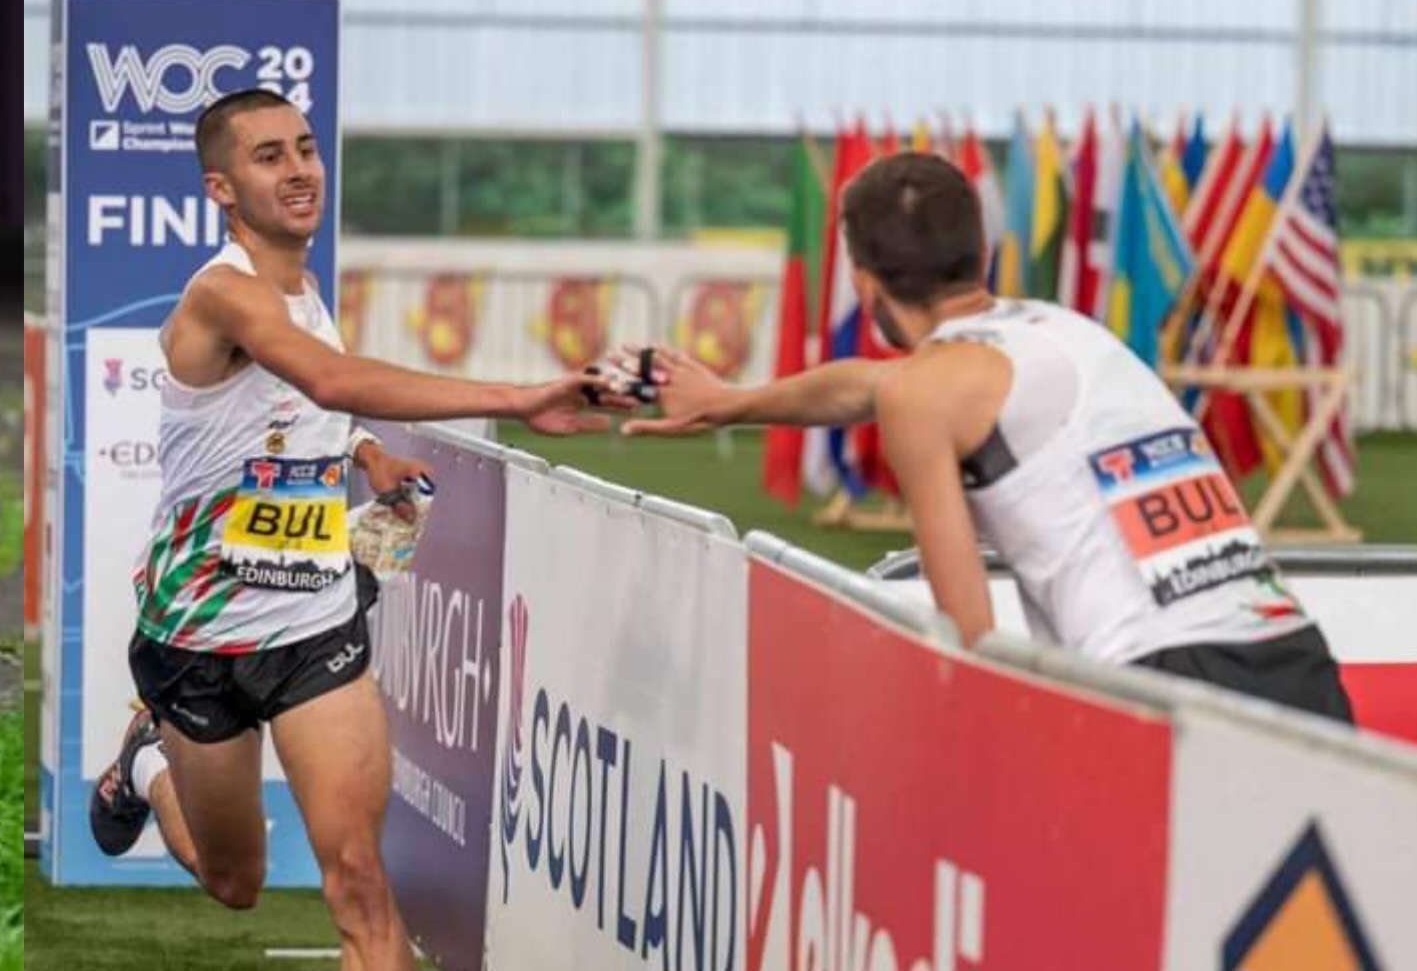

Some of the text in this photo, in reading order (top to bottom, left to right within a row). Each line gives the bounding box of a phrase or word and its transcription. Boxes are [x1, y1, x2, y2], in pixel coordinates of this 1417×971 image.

[86, 43, 252, 115] WOC
[256, 46, 314, 80] 20
[261, 82, 314, 115] 4
[88, 195, 227, 248] FINI
[246, 502, 332, 542] BUL
[1139, 475, 1240, 539] BUL
[236, 566, 334, 590] EDINBURGH
[526, 687, 738, 971] SCOTLAND
